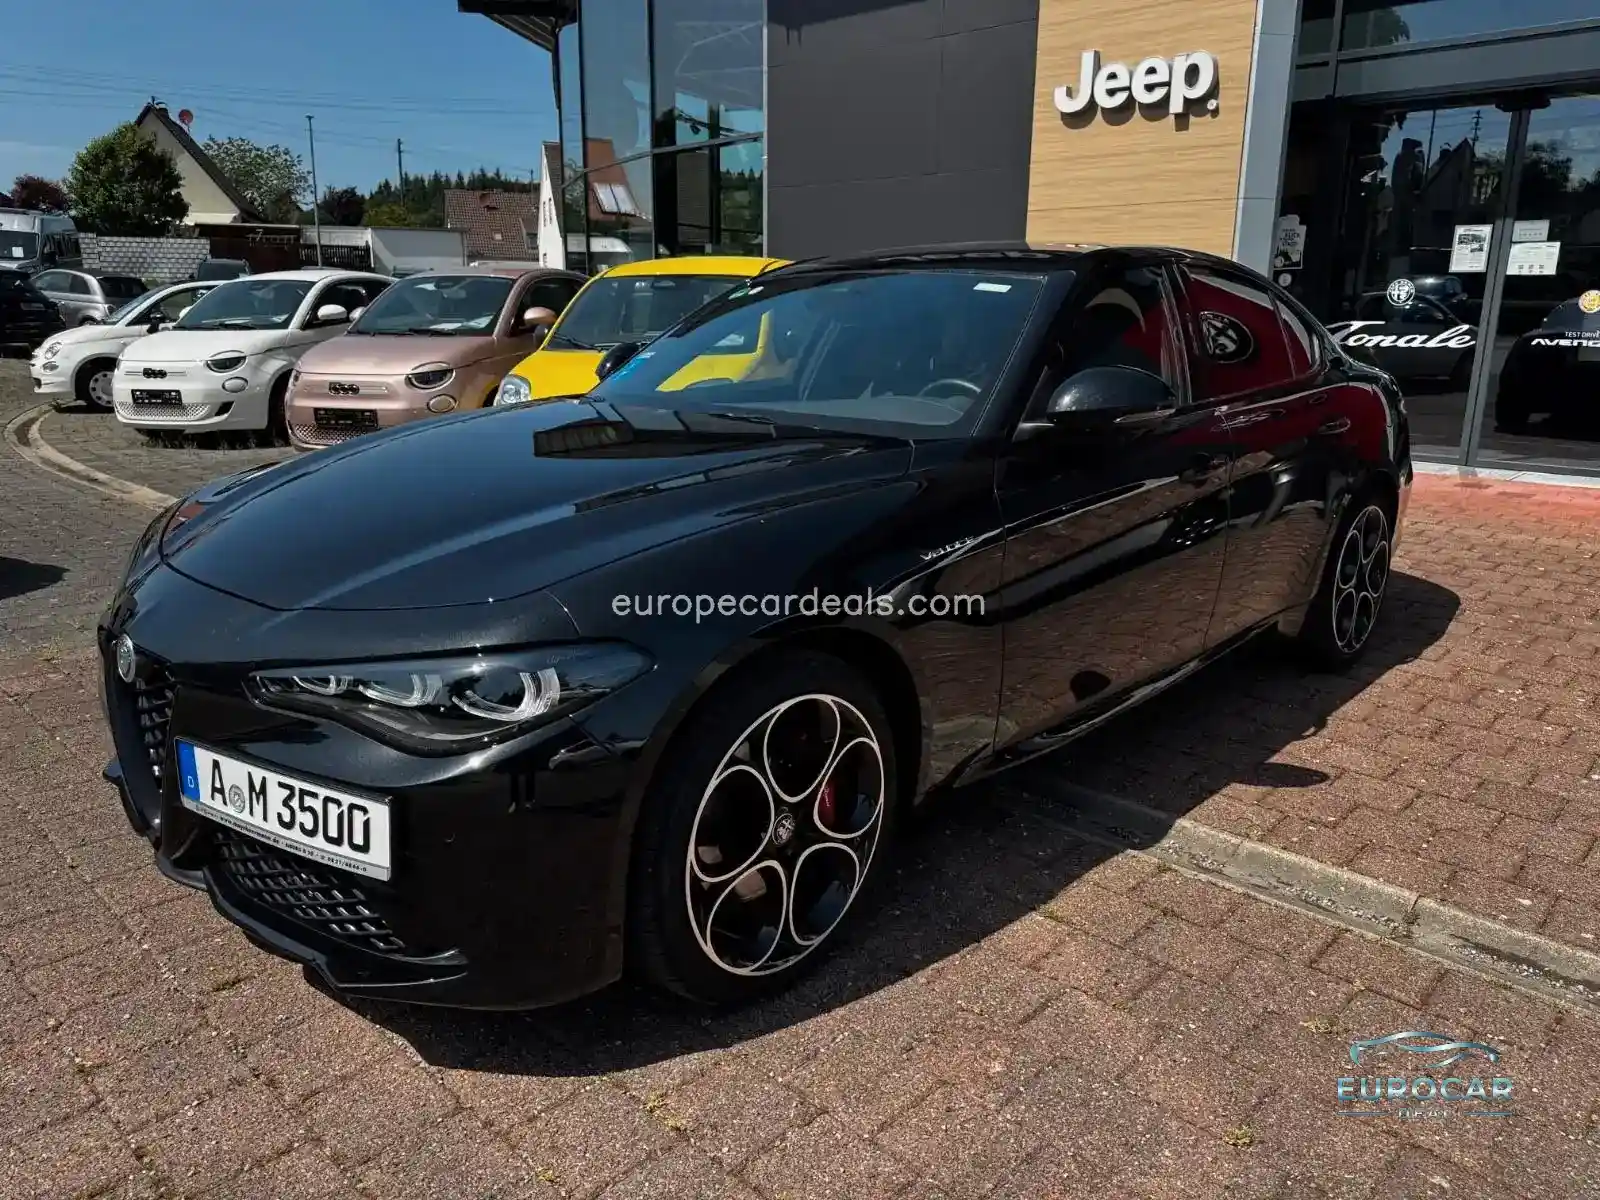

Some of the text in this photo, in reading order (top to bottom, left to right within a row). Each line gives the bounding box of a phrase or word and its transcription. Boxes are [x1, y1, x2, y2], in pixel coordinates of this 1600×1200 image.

[1053, 49, 1218, 114] Jeep
[1324, 320, 1476, 349] Tonale
[187, 775, 194, 788] D
[210, 758, 371, 854] A M 3500
